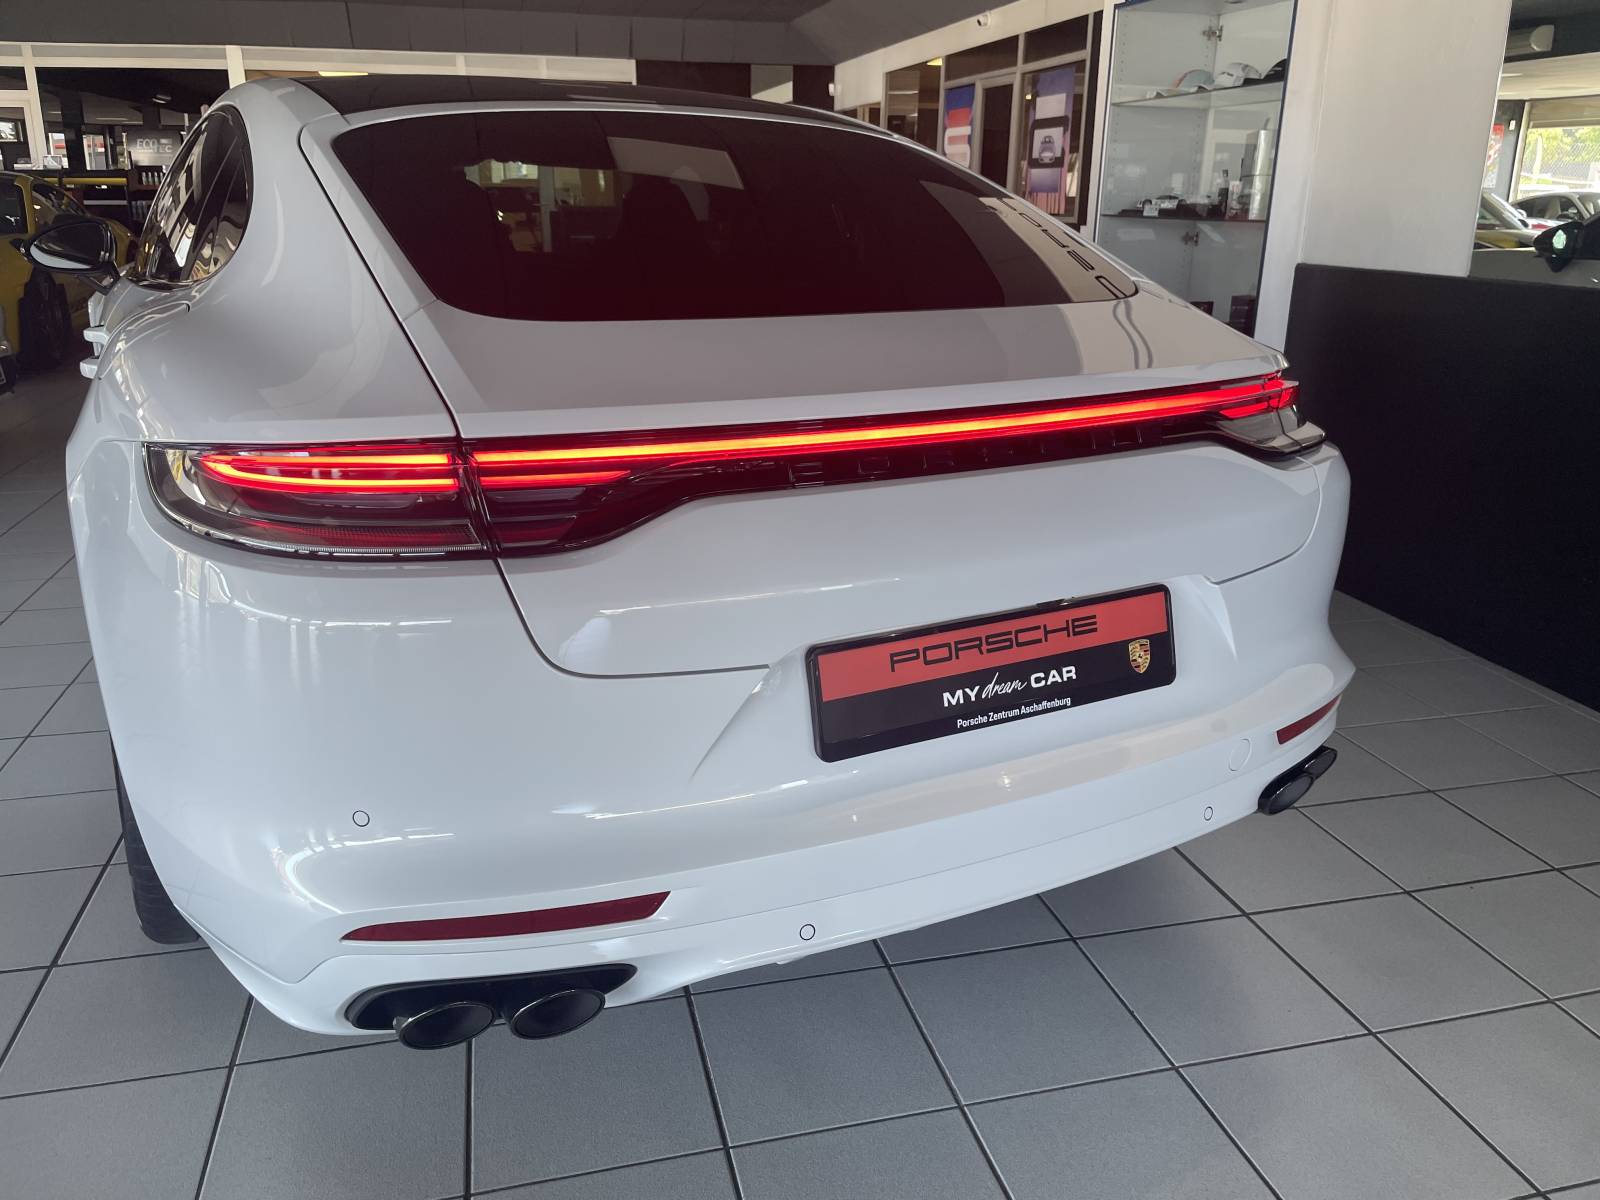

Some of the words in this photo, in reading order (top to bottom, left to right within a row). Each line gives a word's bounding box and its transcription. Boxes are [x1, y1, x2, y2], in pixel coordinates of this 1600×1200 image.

[889, 614, 1098, 673] PORSCHE
[942, 685, 980, 707] MY
[981, 672, 1028, 699] dream
[1030, 665, 1077, 688] CAR
[957, 715, 988, 729] Porsche
[988, 708, 1020, 722] Zentrum
[1020, 696, 1071, 716] Aschaffenburg
